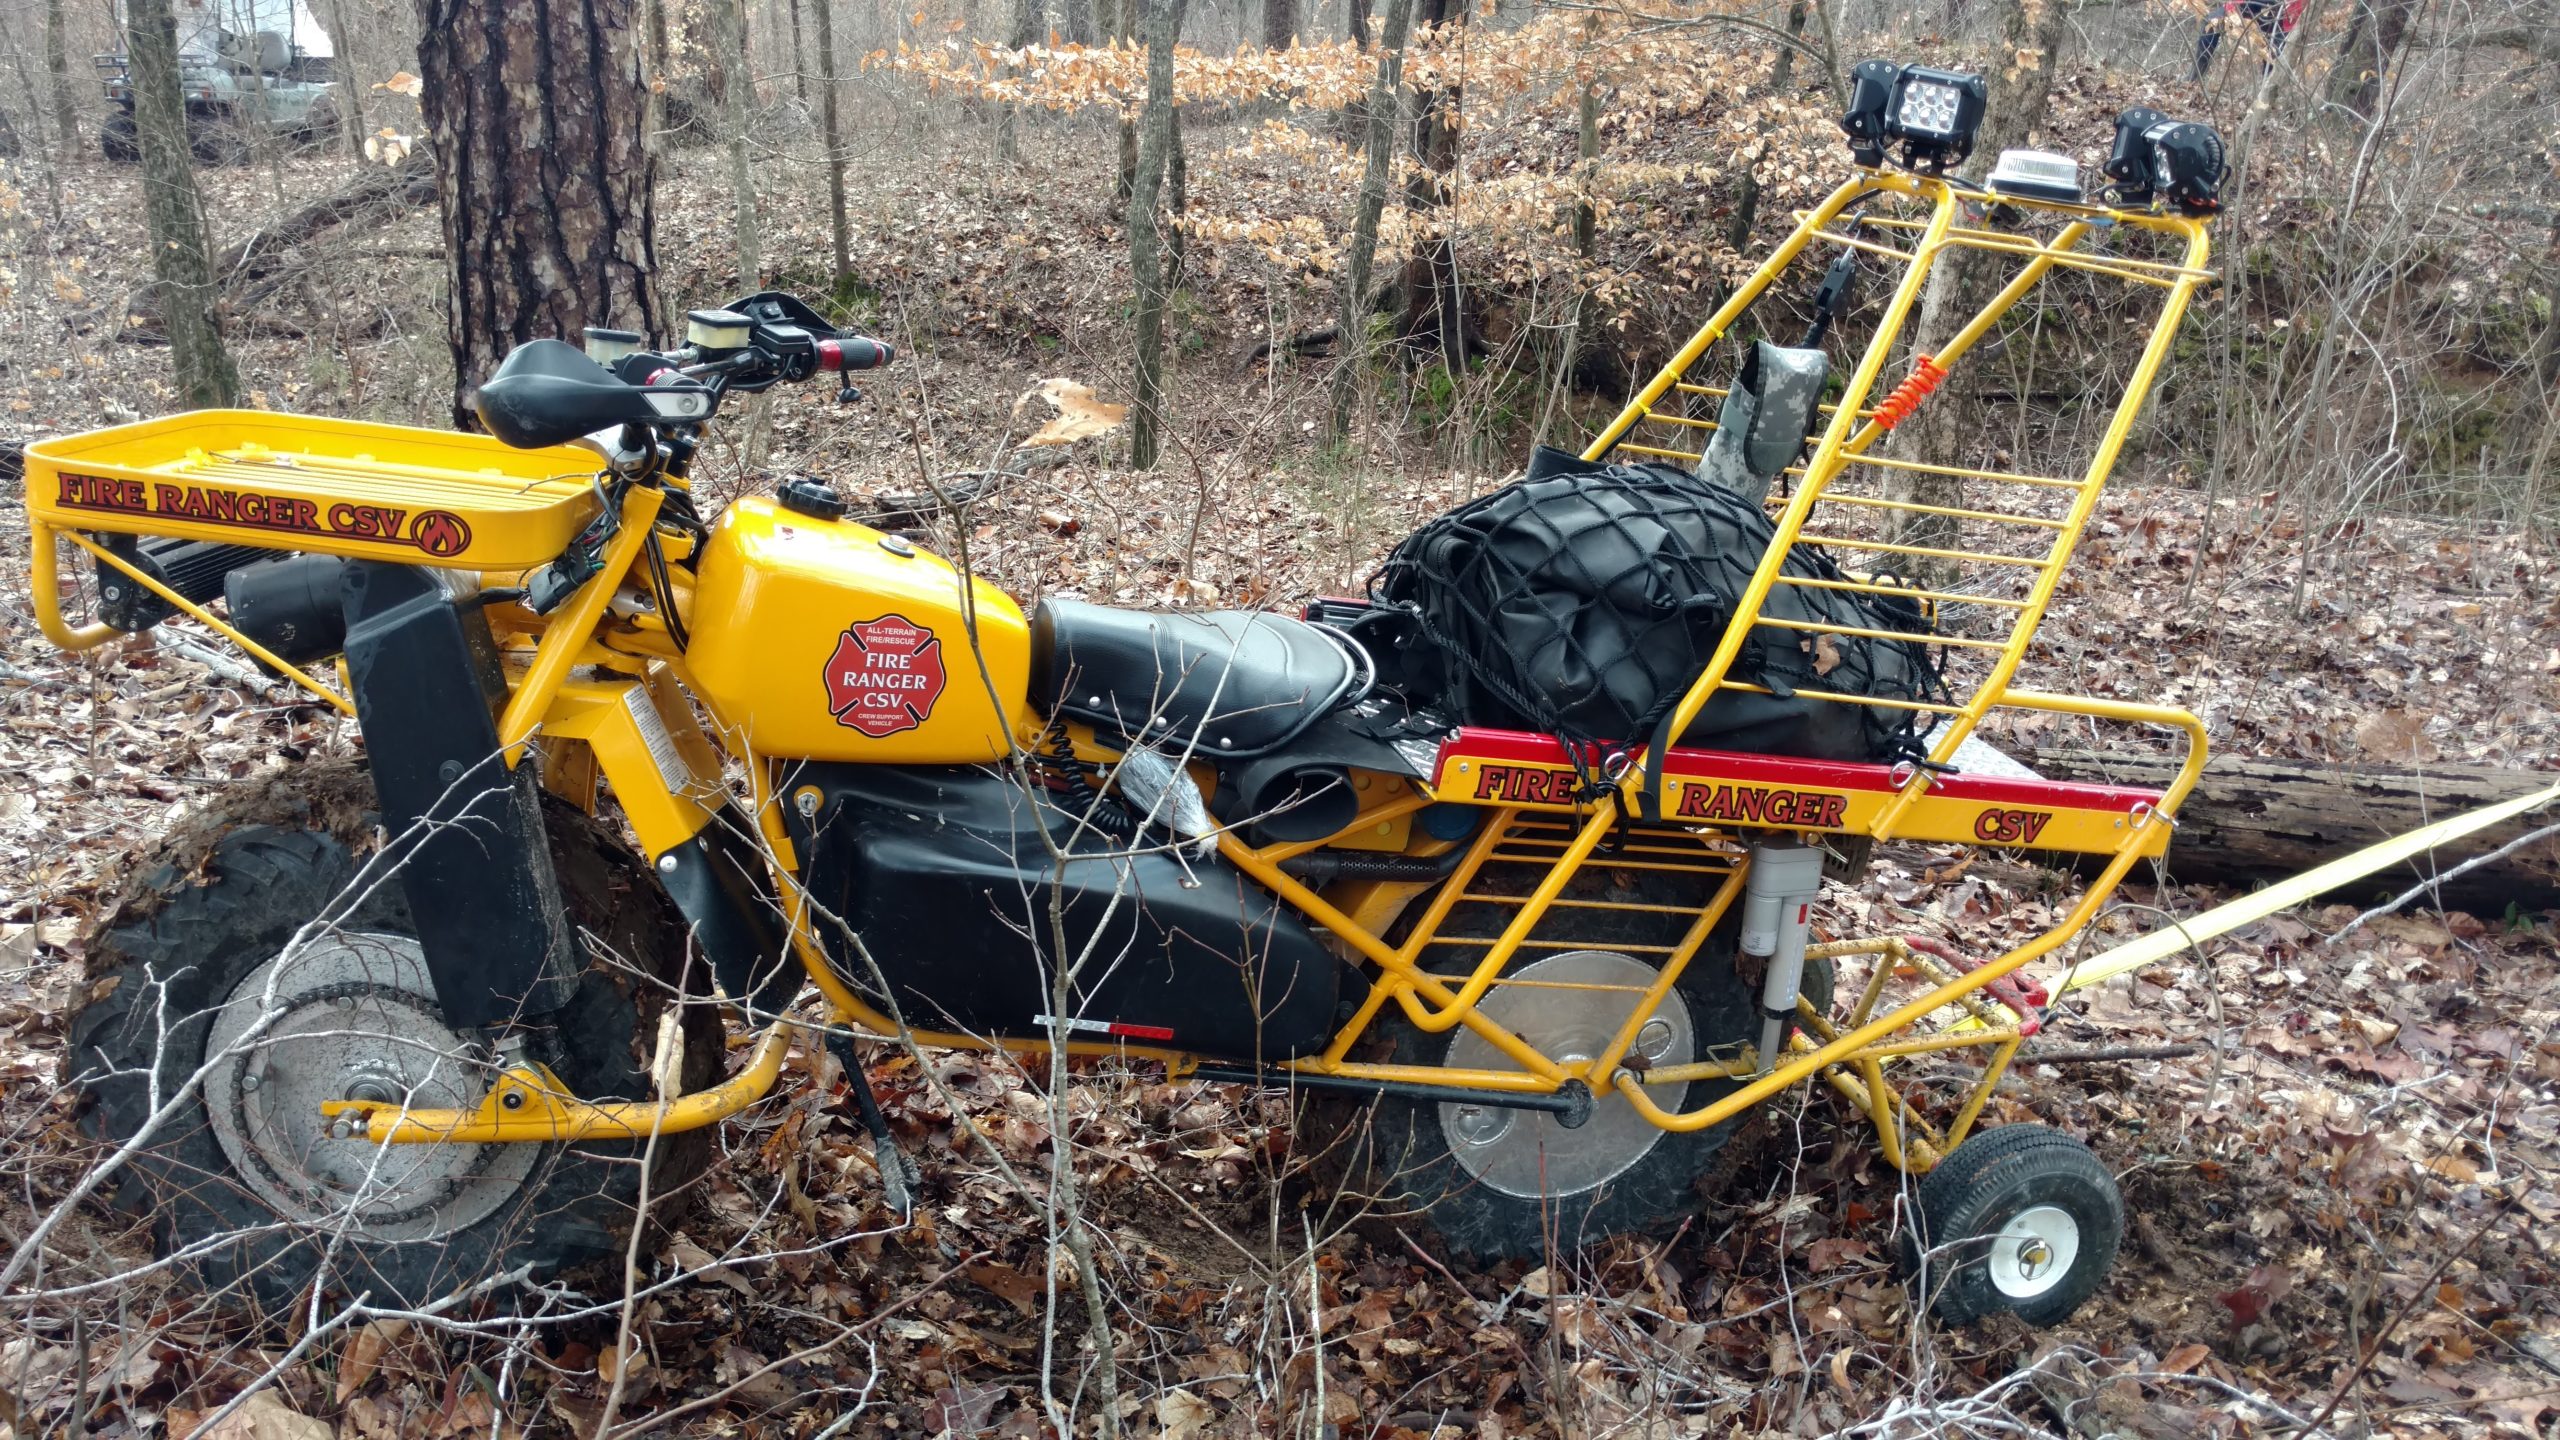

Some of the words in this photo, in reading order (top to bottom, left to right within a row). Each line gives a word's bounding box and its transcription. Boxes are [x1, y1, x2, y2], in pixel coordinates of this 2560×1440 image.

[58, 472, 147, 510] FIRE
[154, 483, 321, 530] RANGER
[328, 503, 407, 539] CSV
[867, 627, 917, 636] ALL-TERRAIN
[866, 636, 916, 645] FIRE/RESCUE
[866, 653, 911, 669] FIRE
[843, 672, 927, 689] RANGER
[863, 693, 903, 708] CSV
[1474, 764, 1578, 805] FIRE
[1676, 782, 1848, 828] RANGER
[1974, 808, 2053, 843] CSV
